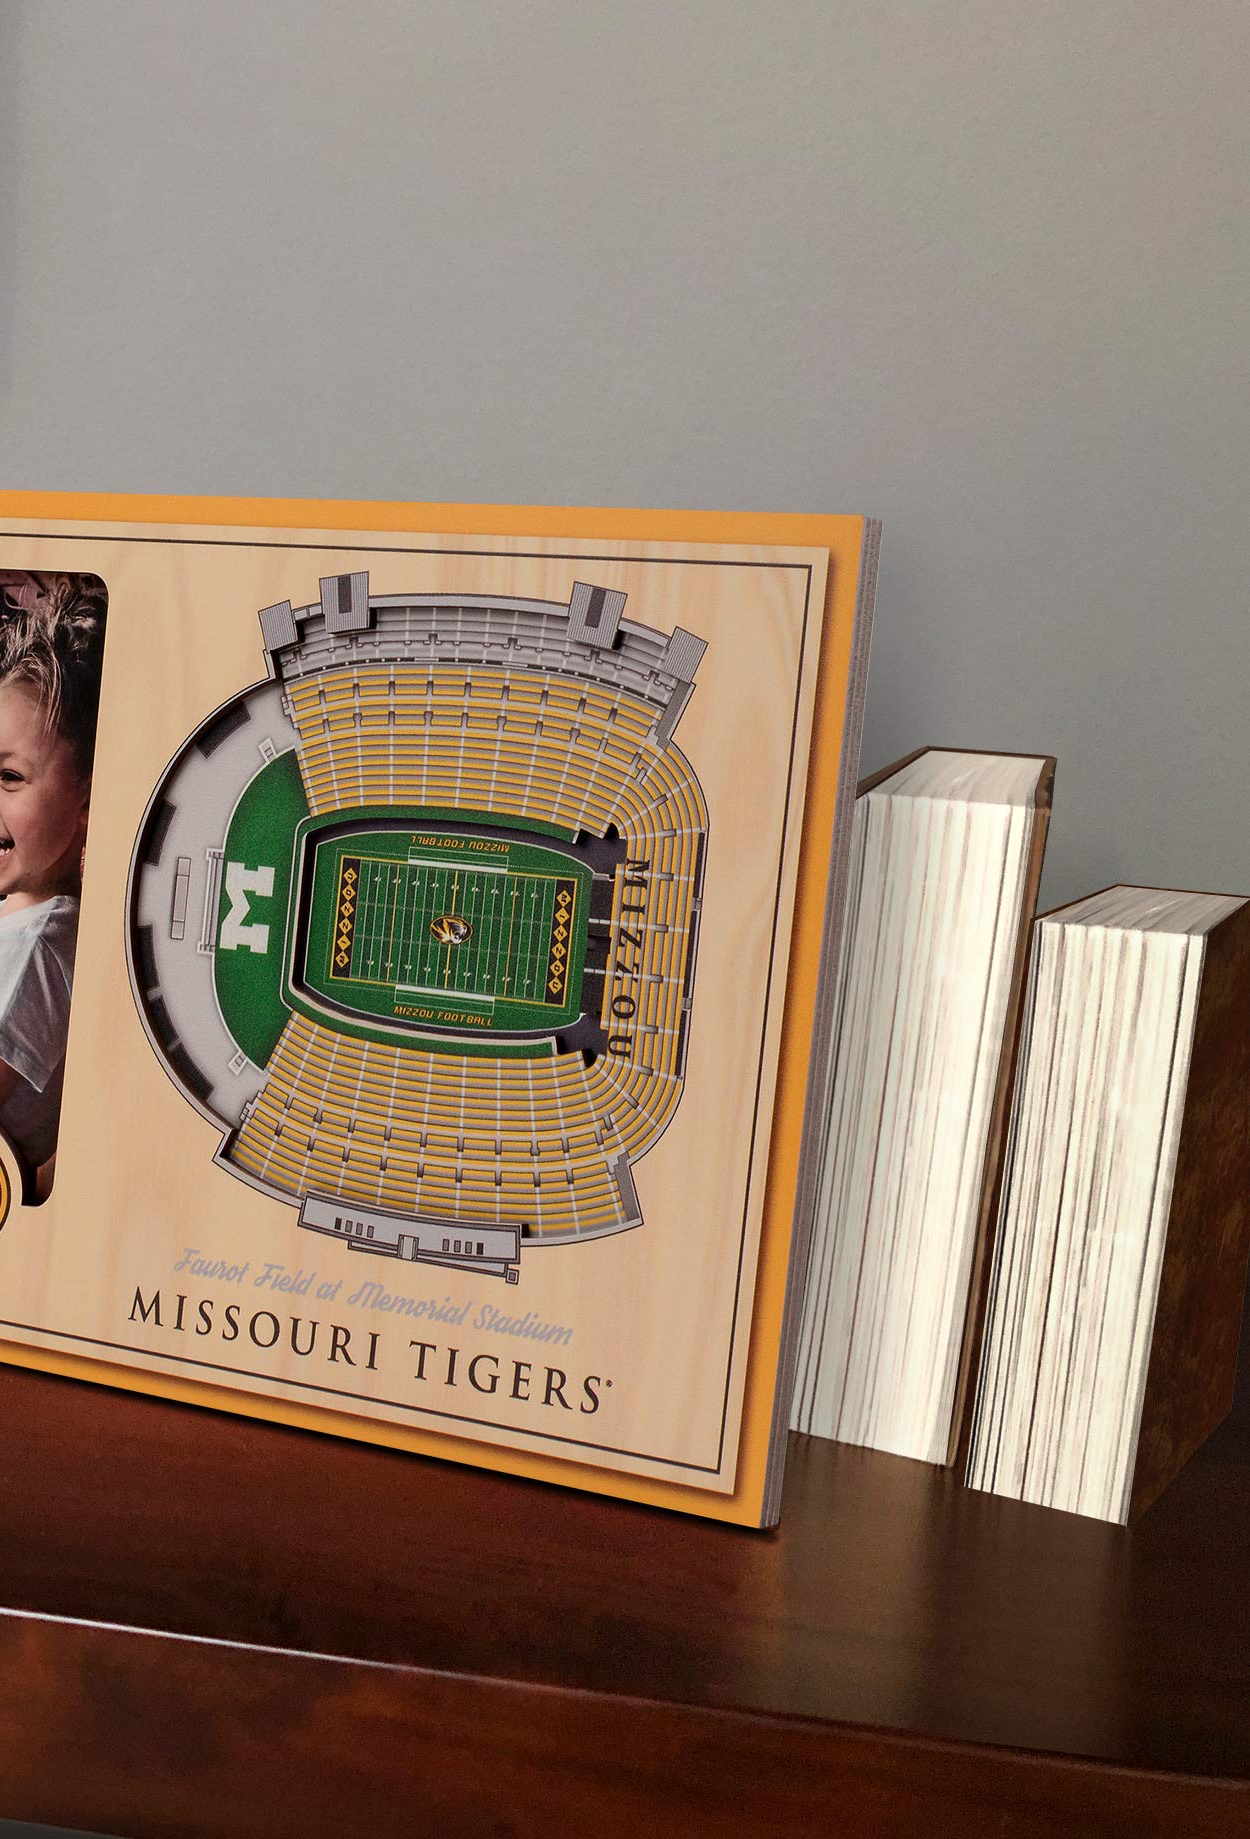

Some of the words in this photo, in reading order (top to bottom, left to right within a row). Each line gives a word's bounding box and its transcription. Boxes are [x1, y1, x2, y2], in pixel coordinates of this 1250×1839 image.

[411, 835, 465, 849] FOOTBALL
[468, 840, 510, 853] MIZZOU
[219, 861, 275, 954] M
[608, 857, 651, 1059] MIZZOU
[393, 1006, 434, 1019] MIZZOU
[437, 1011, 493, 1026] FOOTBALL
[127, 1285, 382, 1371] MISSOURI
[173, 1247, 250, 1285] Faurot
[252, 1261, 316, 1297] Field
[316, 1276, 343, 1302] at
[347, 1281, 472, 1327] Memorial
[472, 1303, 575, 1346] Stadium
